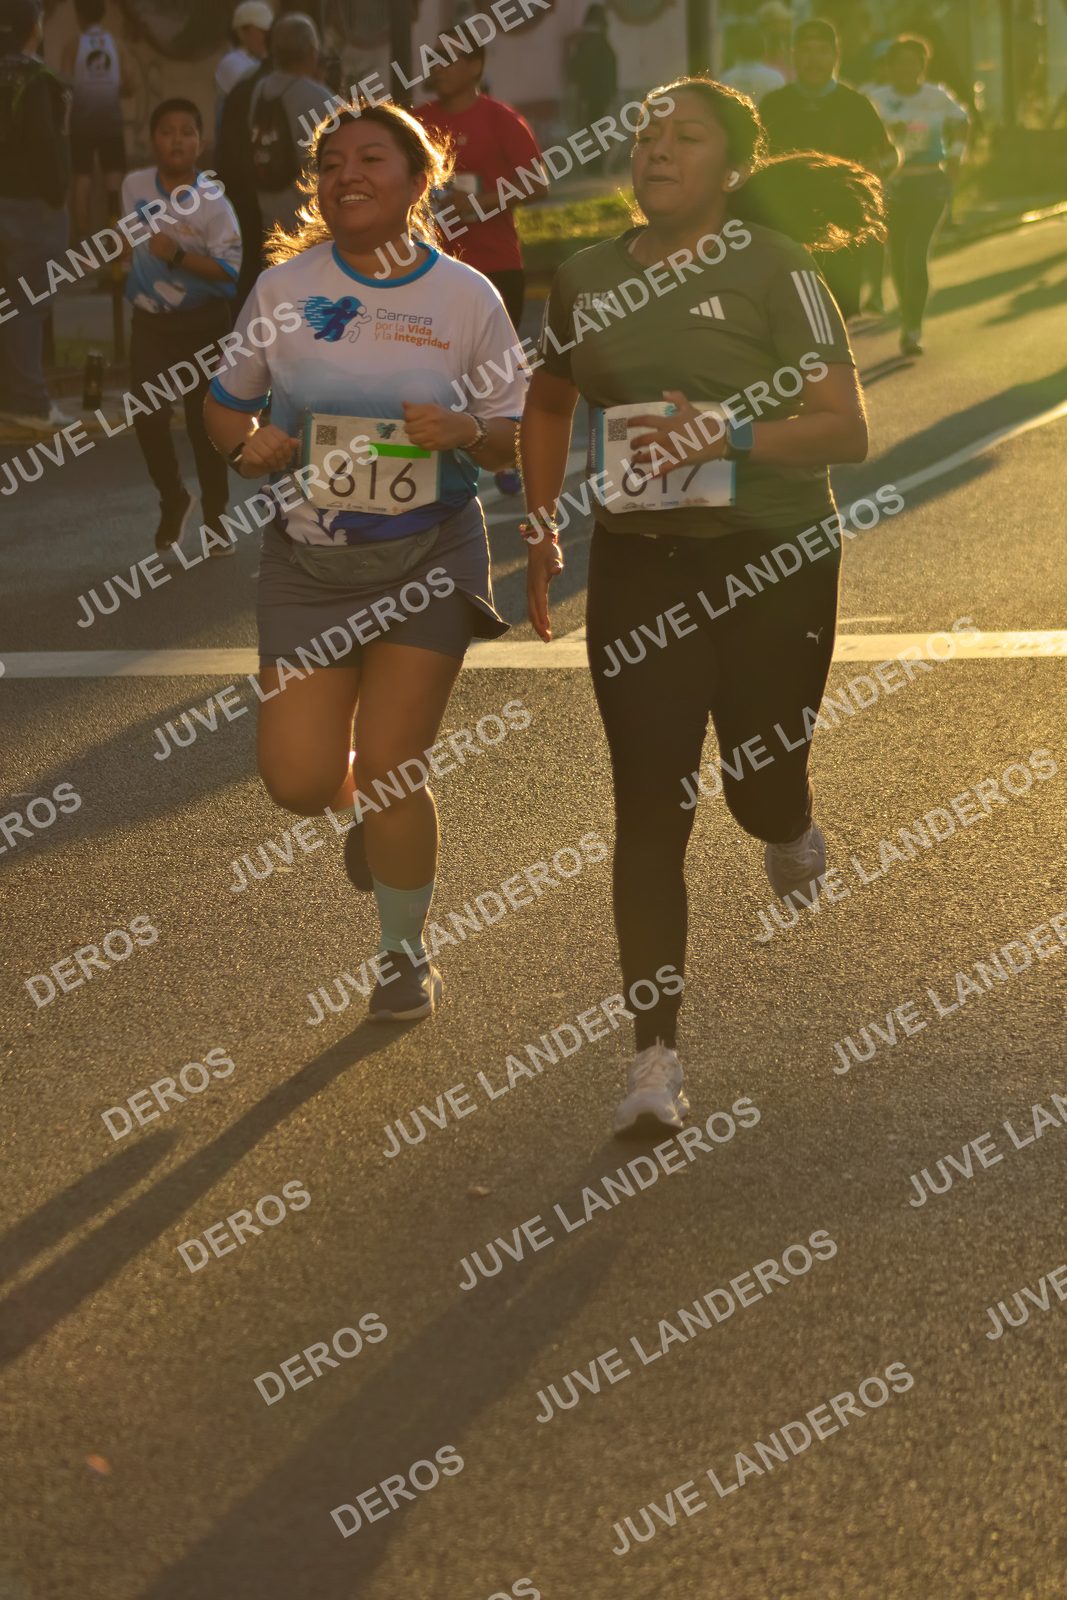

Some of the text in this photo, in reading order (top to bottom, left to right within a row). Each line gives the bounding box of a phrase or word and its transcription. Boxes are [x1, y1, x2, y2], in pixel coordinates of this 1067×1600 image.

[376, 308, 433, 325] Carrera
[375, 322, 432, 336] por la Vida
[383, 331, 392, 341] la
[394, 333, 451, 350] Integridad
[329, 457, 416, 503] 616
